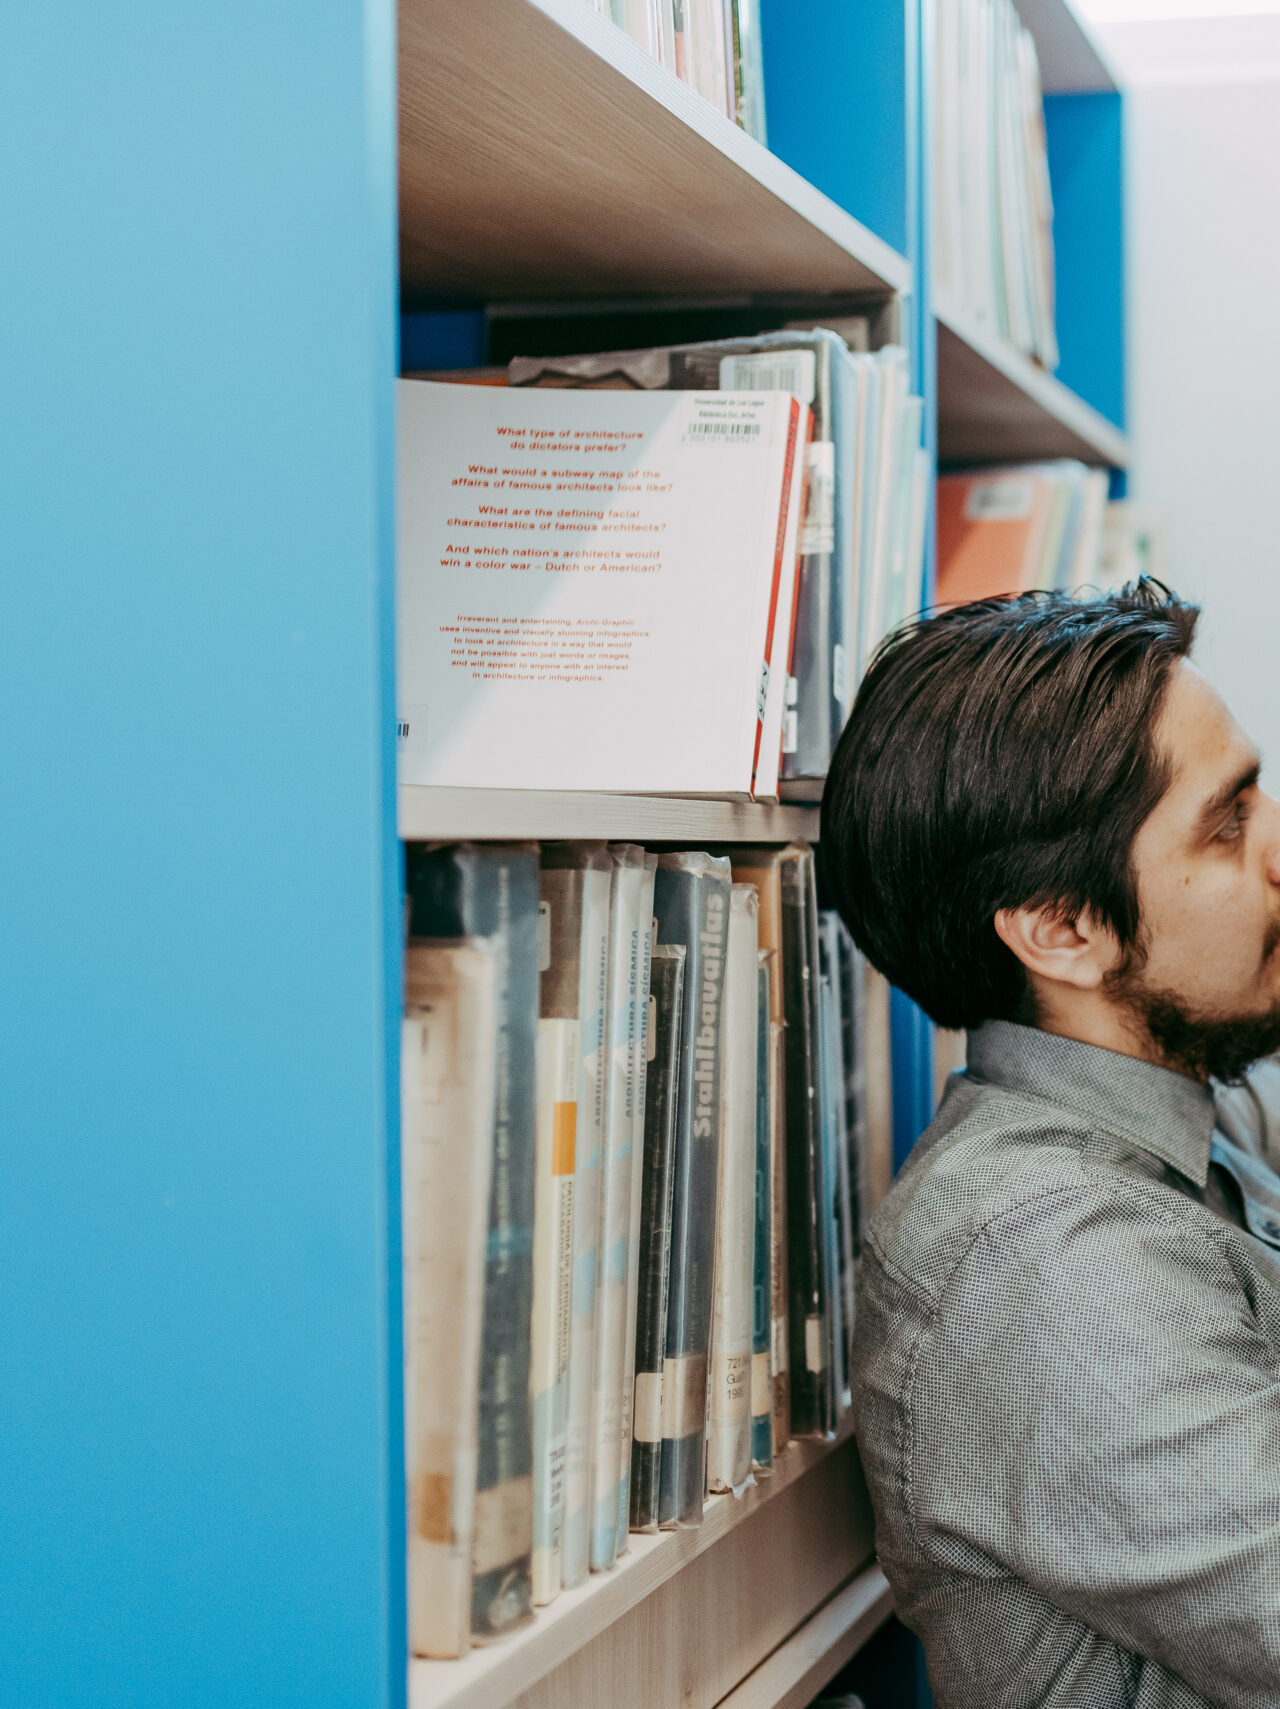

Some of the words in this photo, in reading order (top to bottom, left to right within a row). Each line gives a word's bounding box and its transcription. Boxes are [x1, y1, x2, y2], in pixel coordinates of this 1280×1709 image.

[497, 426, 526, 437] What
[530, 428, 555, 439] type
[559, 429, 571, 438] of
[574, 430, 643, 439] architecture
[510, 441, 525, 450] do
[529, 441, 580, 451] dictators
[584, 442, 627, 454] prefer?
[468, 464, 498, 475] What
[502, 467, 536, 477] would
[552, 469, 595, 480] subway
[599, 471, 624, 480] map
[628, 470, 639, 478] of
[643, 470, 660, 478] the
[451, 478, 489, 488] affairs
[494, 480, 505, 489] of
[509, 480, 551, 490] famous
[556, 482, 613, 492] architects
[618, 483, 641, 492] look
[647, 483, 673, 492] like?
[478, 505, 508, 515] What
[512, 508, 531, 516] are
[535, 508, 553, 517] the
[557, 509, 604, 520] defining
[609, 510, 640, 519] facial
[447, 518, 535, 530] characteristics
[540, 522, 551, 530] of
[555, 522, 597, 531] famous
[602, 523, 666, 532] architects?
[445, 544, 470, 554] And
[474, 546, 509, 556] which
[513, 547, 559, 558] nation's
[563, 549, 621, 559] architects
[626, 551, 660, 560] would
[440, 558, 460, 567] win
[465, 560, 471, 568] a
[475, 560, 506, 570] color
[510, 562, 531, 570] war
[545, 562, 579, 571] Dutch
[584, 564, 595, 572] or
[600, 563, 662, 573] American?
[454, 636, 463, 644] to
[465, 637, 483, 645] look
[497, 638, 548, 647] architecture
[450, 648, 465, 656] not
[467, 648, 478, 656] be
[481, 649, 517, 657] possible
[488, 661, 516, 669] appeal
[483, 672, 534, 680] architecture
[693, 892, 725, 1139] Stahlbauatlas
[625, 1001, 635, 1118] ARQUITECTURA
